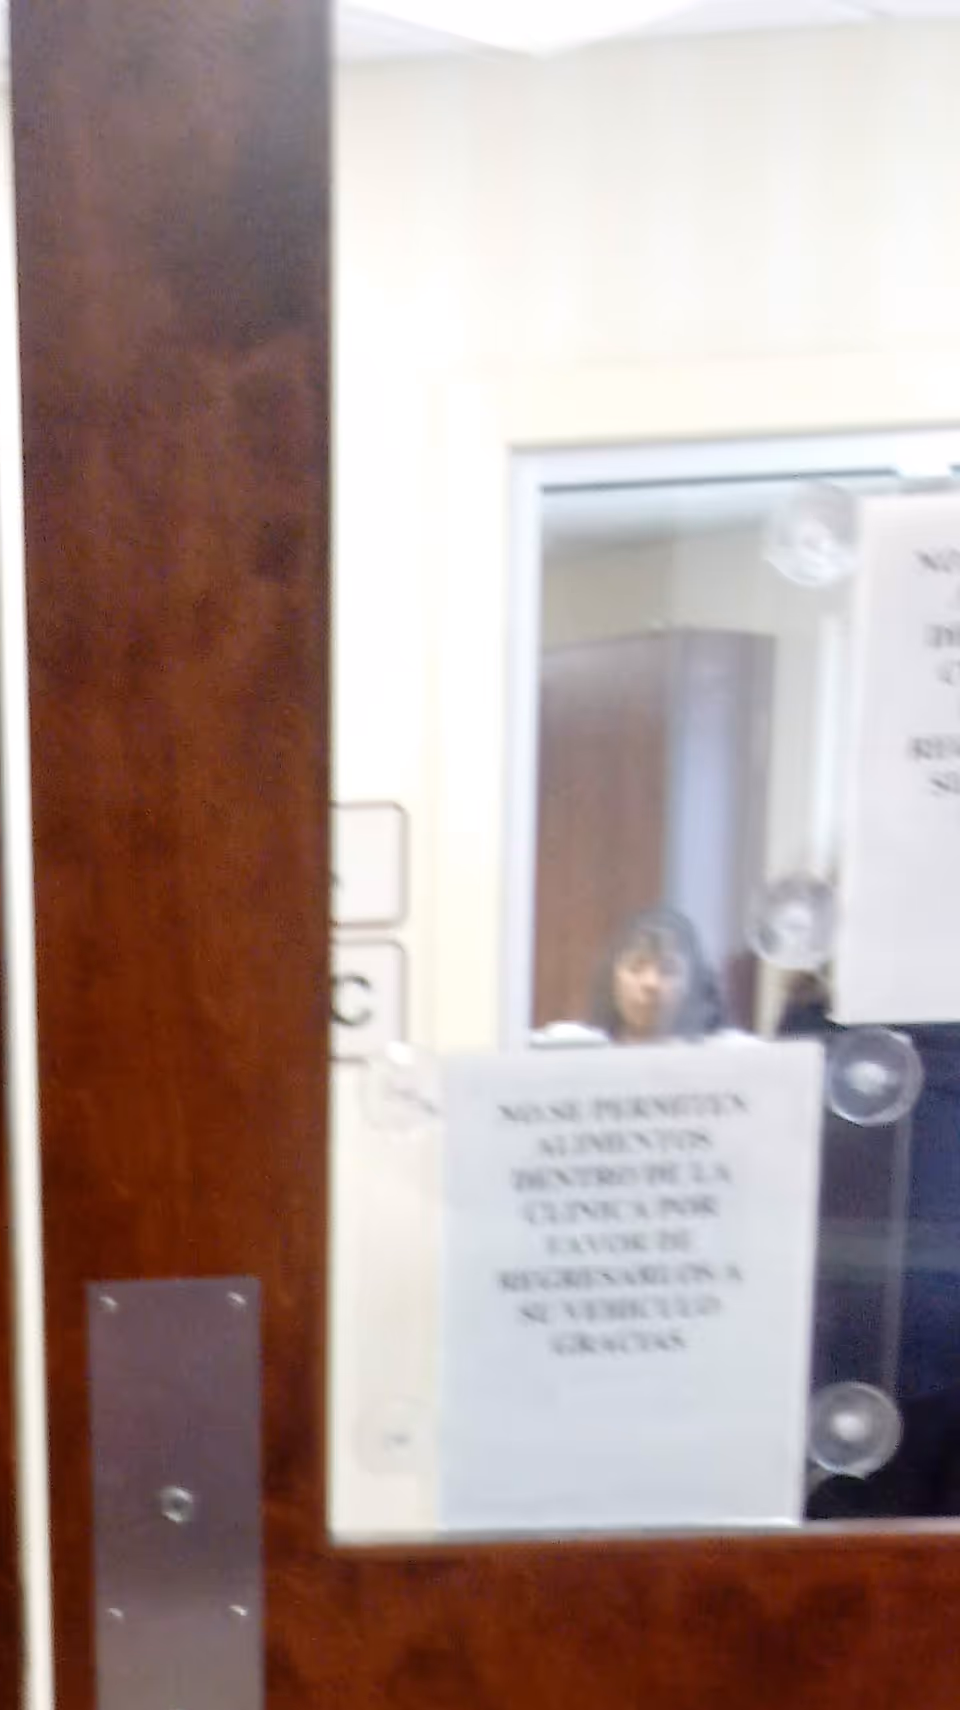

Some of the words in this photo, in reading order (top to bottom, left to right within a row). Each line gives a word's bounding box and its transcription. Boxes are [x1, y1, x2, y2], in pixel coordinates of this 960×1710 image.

[498, 1103, 543, 1124] NO
[548, 1102, 579, 1123] SE
[593, 1093, 749, 1121] PERMITEN
[538, 1129, 714, 1157] ALIMENTOS
[511, 1166, 639, 1192] DENTRO
[644, 1162, 677, 1187] DE
[690, 1160, 735, 1185] LA
[522, 1199, 650, 1225] CLINICA
[657, 1195, 720, 1221] POR
[545, 1231, 647, 1256] FAVOR
[656, 1228, 691, 1253] DE
[496, 1263, 715, 1294] REGRESARLOS
[722, 1262, 744, 1282] A
[515, 1301, 549, 1326] SU
[562, 1295, 724, 1322] VEHICULO
[548, 1331, 690, 1359] GRACIAS
